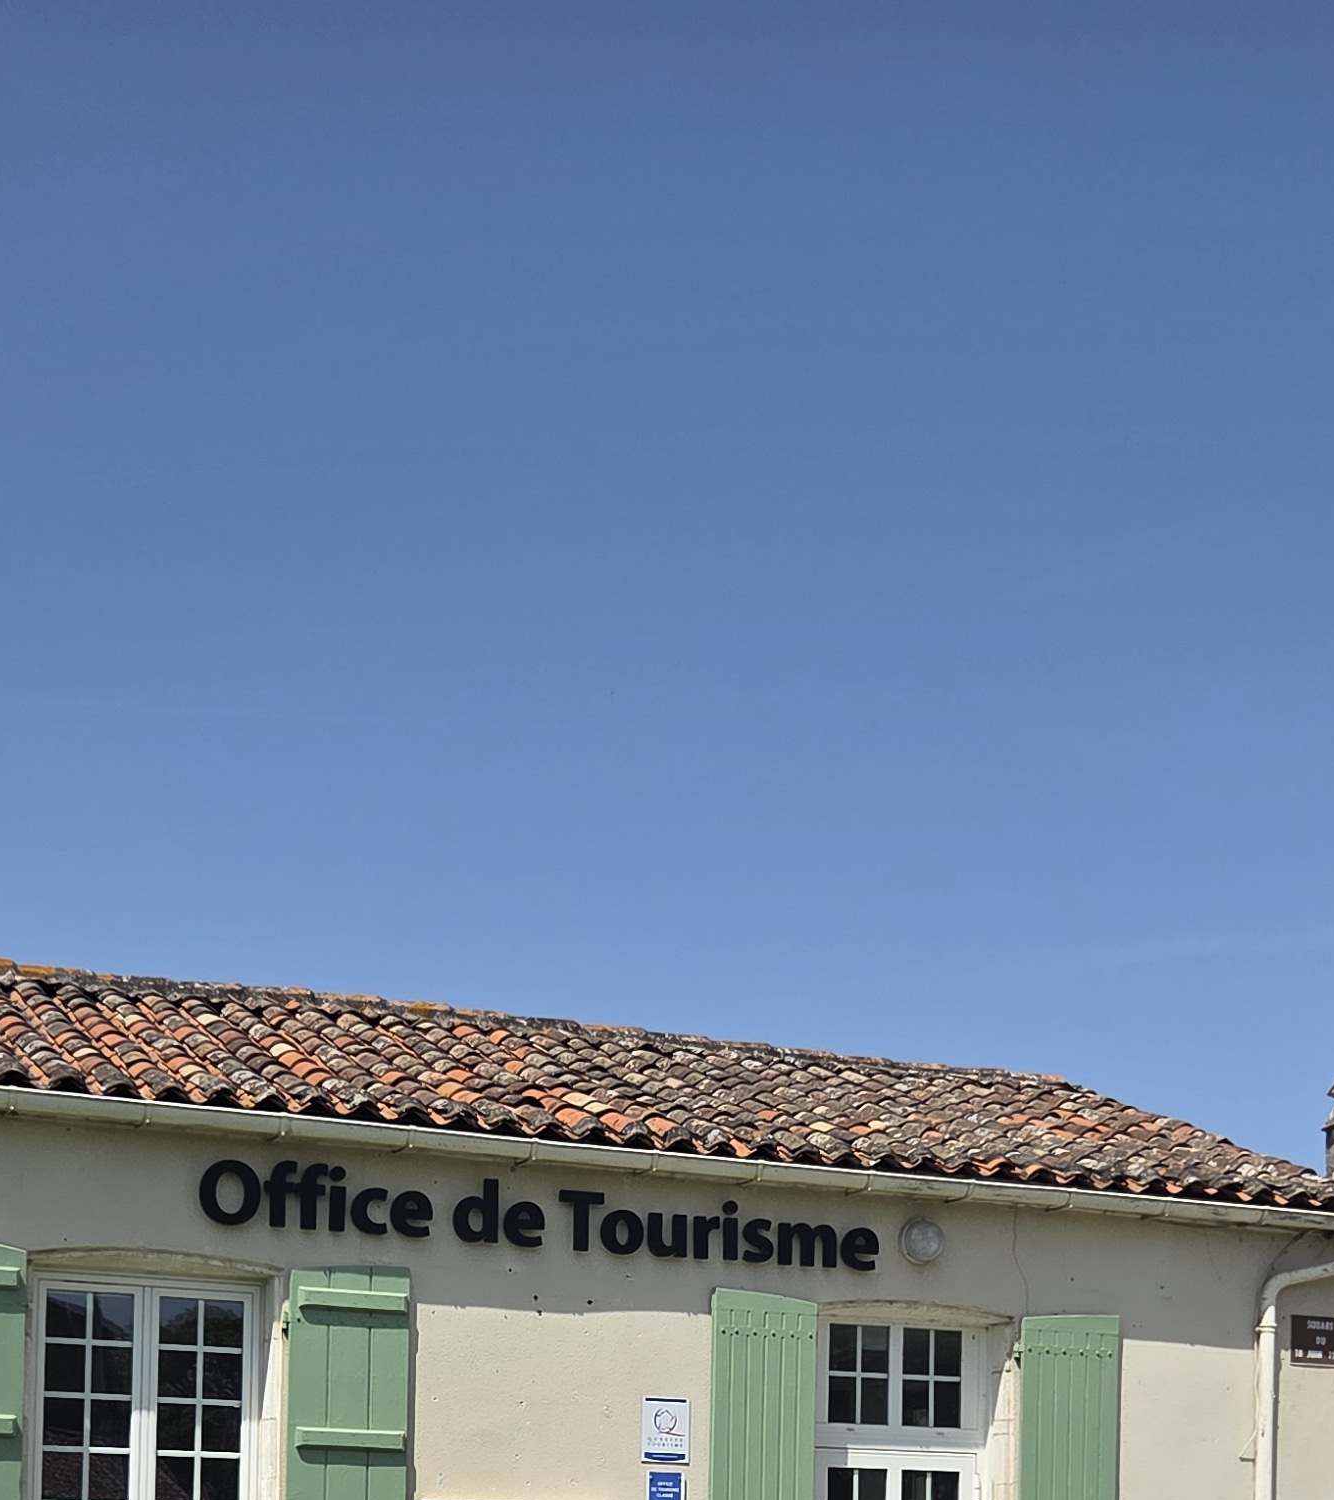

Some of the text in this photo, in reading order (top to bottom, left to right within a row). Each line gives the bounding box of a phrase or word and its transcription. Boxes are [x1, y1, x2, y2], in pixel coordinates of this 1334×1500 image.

[199, 1160, 881, 1272] Office de Tourisme
[1306, 1319, 1334, 1331] SQUARE
[1315, 1335, 1327, 1346] DU
